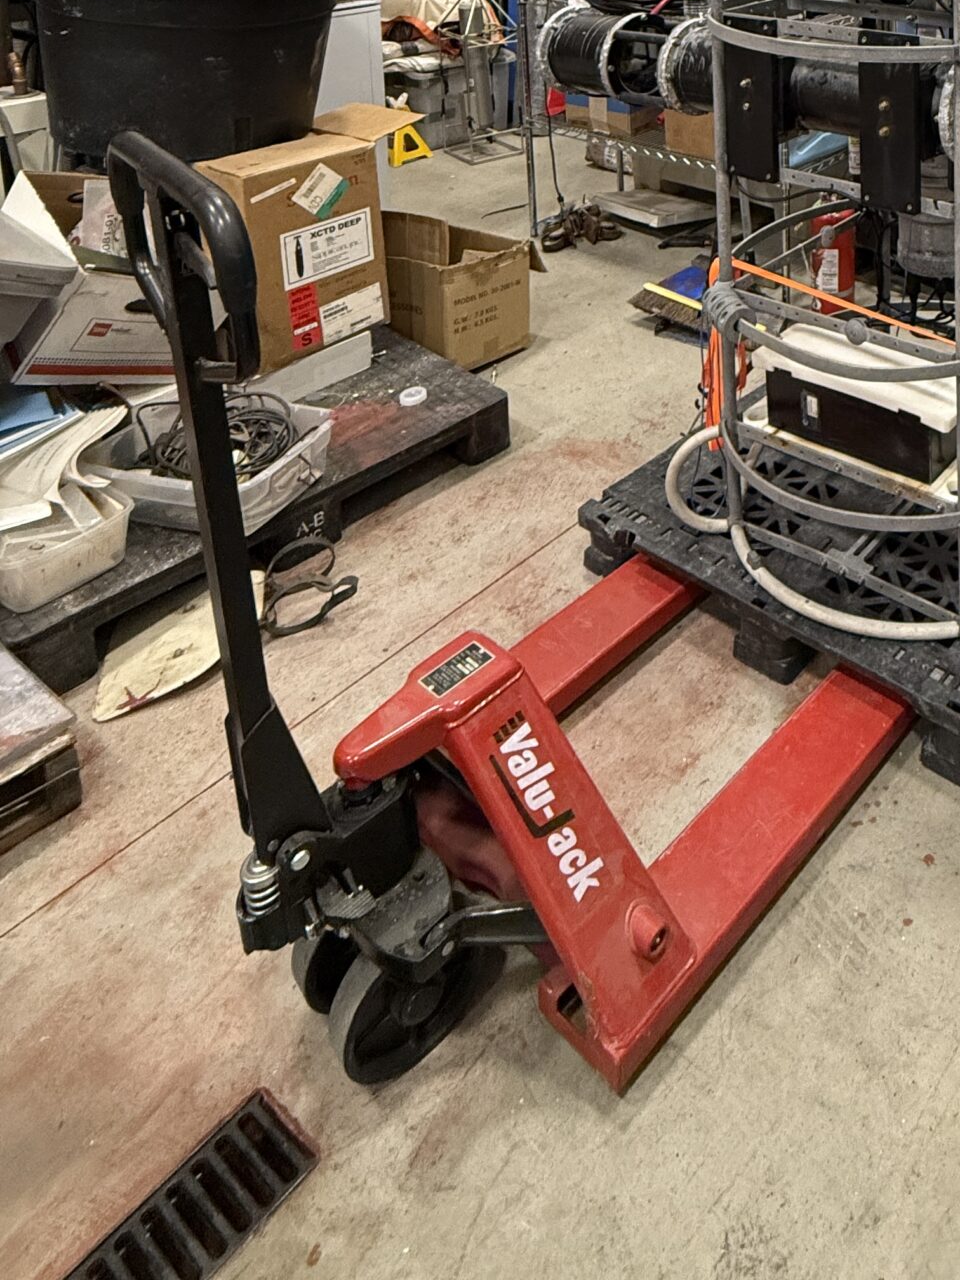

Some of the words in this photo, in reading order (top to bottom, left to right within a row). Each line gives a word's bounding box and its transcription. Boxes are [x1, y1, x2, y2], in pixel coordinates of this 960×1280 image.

[310, 224, 336, 239] XCTD
[337, 217, 362, 231] DEEP
[301, 332, 313, 347] S
[296, 510, 325, 538] A-B
